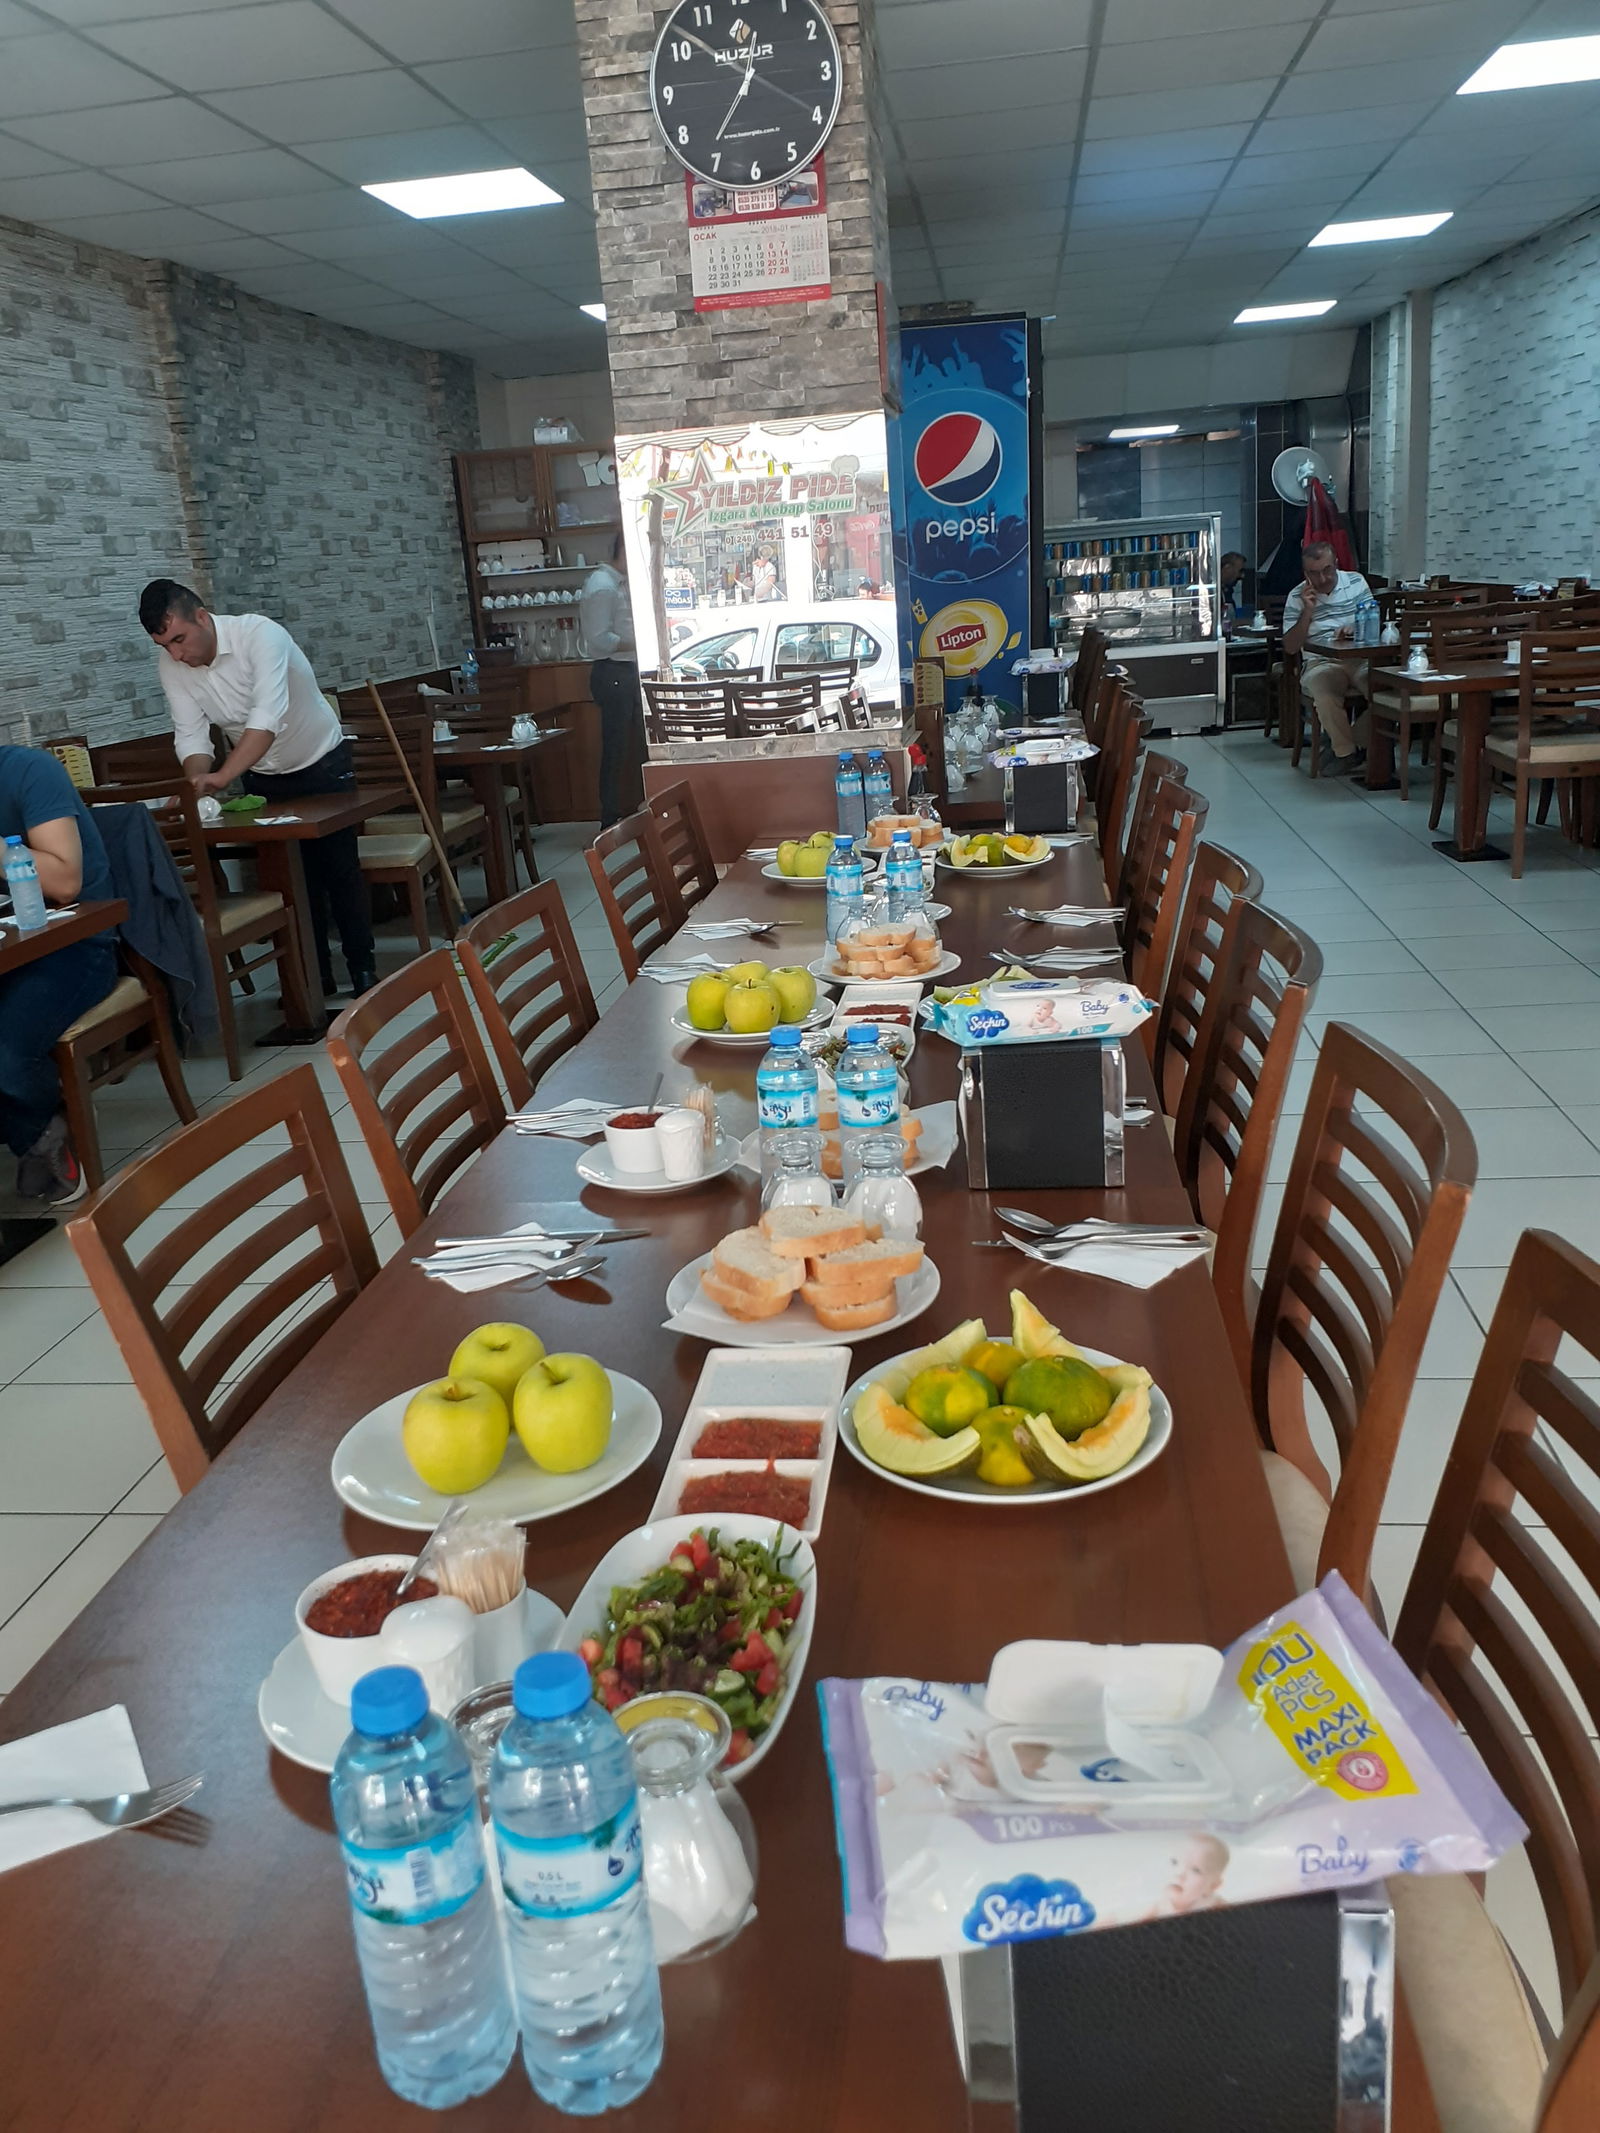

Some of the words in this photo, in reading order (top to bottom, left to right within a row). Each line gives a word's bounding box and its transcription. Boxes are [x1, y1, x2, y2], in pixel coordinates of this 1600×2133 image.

[693, 5, 712, 26] 11
[806, 20, 817, 41] 2
[671, 42, 692, 62] 10
[714, 44, 774, 63] HUZUR
[820, 61, 832, 81] 3
[662, 86, 674, 105] 9
[812, 105, 823, 124] 4
[678, 125, 690, 144] 8
[787, 142, 797, 161] 5
[711, 153, 721, 172] 7
[750, 161, 761, 180] 6
[693, 232, 718, 241] OCAK
[700, 477, 783, 508] YILDIZ
[709, 509, 745, 522] Izgara
[750, 507, 759, 518] &
[763, 502, 804, 517] Kebap
[807, 497, 852, 512] Salonu
[757, 528, 785, 541] 441
[791, 525, 809, 538] 51
[814, 523, 833, 536] 49
[926, 511, 996, 544] pepsi
[940, 626, 982, 648] Lipton
[1080, 999, 1110, 1014] Baby
[1076, 1026, 1094, 1035] 100
[1273, 1668, 1321, 1701] Adet
[1278, 1683, 1336, 1723] PCS
[1292, 1701, 1361, 1751] MAXI
[1304, 1719, 1377, 1765] PACK
[993, 1816, 1043, 1840] 100
[1296, 1836, 1370, 1875] Baby
